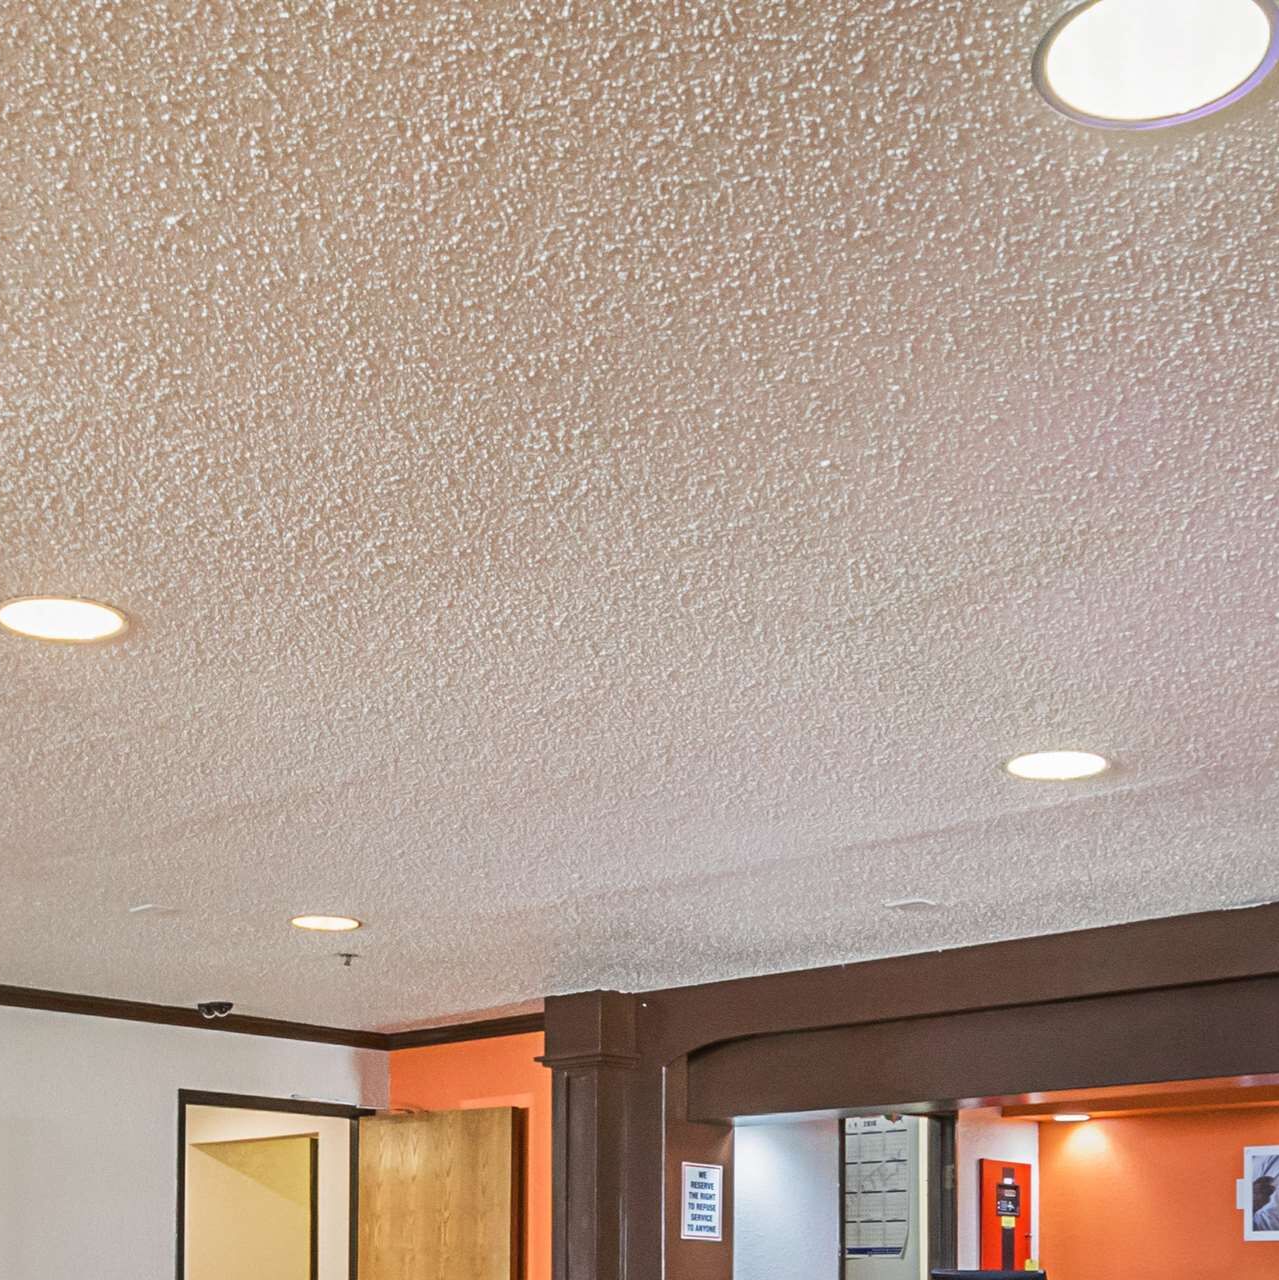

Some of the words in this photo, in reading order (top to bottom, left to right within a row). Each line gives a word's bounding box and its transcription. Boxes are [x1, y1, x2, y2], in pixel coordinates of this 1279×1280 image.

[699, 1171, 707, 1179] WE
[690, 1181, 714, 1190] RESERVE
[689, 1191, 698, 1199] THE
[700, 1192, 715, 1201] RIGHT
[688, 1202, 695, 1210] TO
[696, 1203, 716, 1212] REFUSE
[691, 1213, 712, 1222] SERVICE
[687, 1224, 694, 1232] TO
[695, 1224, 716, 1233] ANYONE
